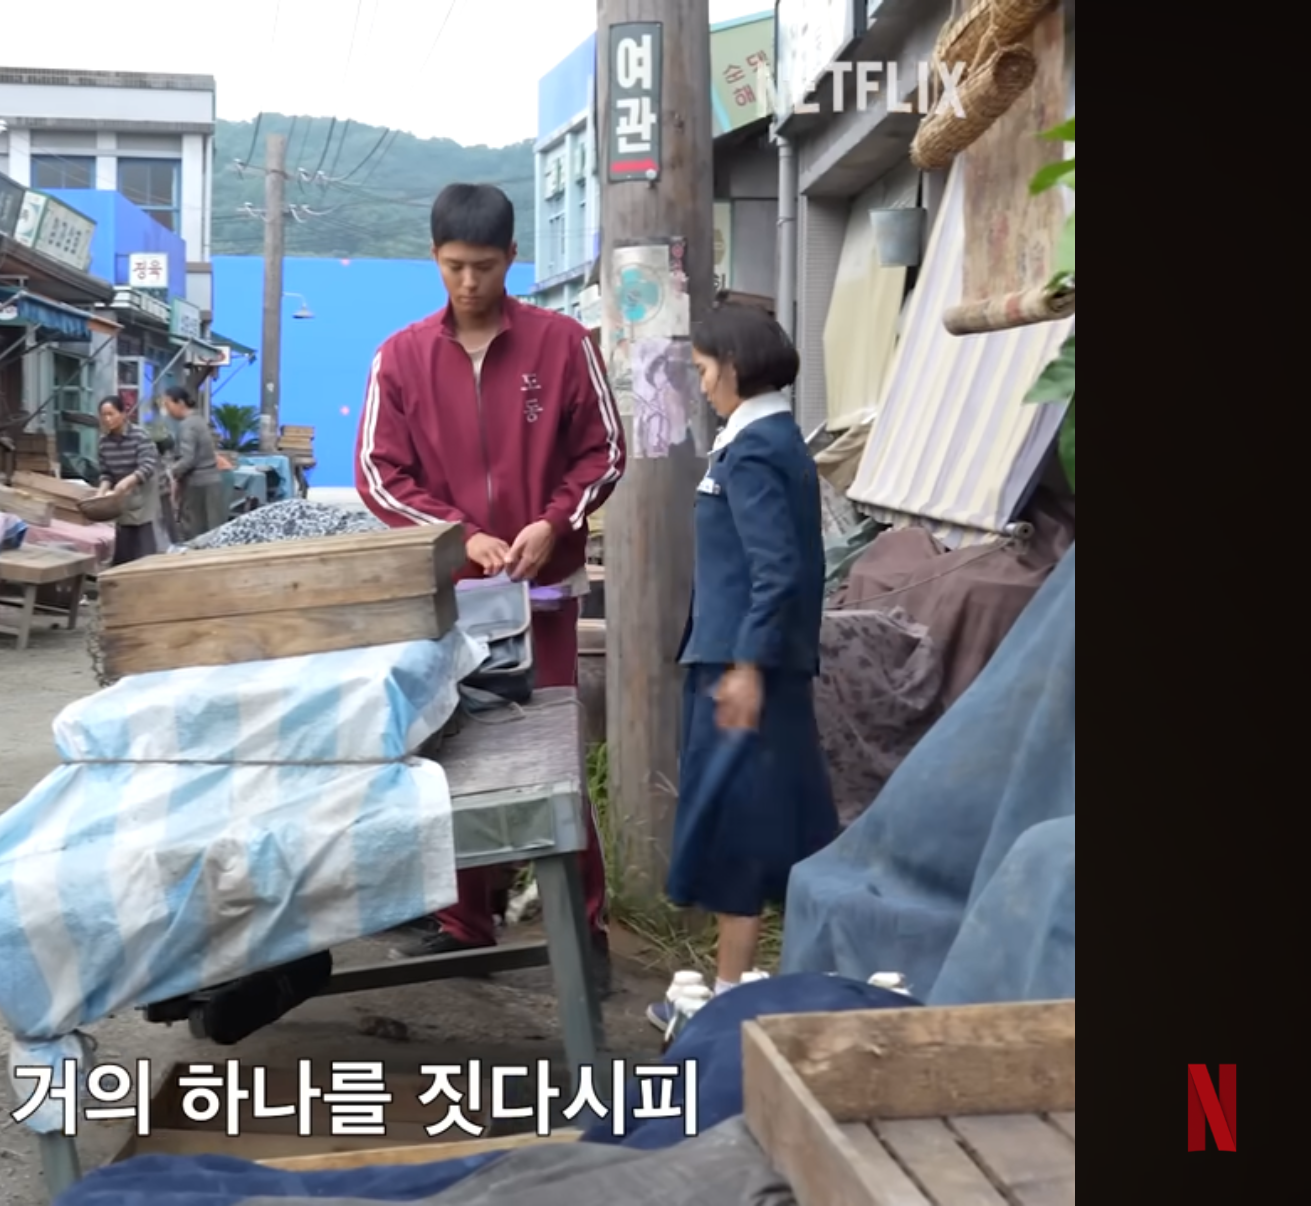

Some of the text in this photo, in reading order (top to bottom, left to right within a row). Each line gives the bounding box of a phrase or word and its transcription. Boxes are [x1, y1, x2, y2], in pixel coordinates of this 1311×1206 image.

[616, 34, 657, 154] 여관
[133, 259, 163, 281] 정육
[518, 373, 545, 424] 도동
